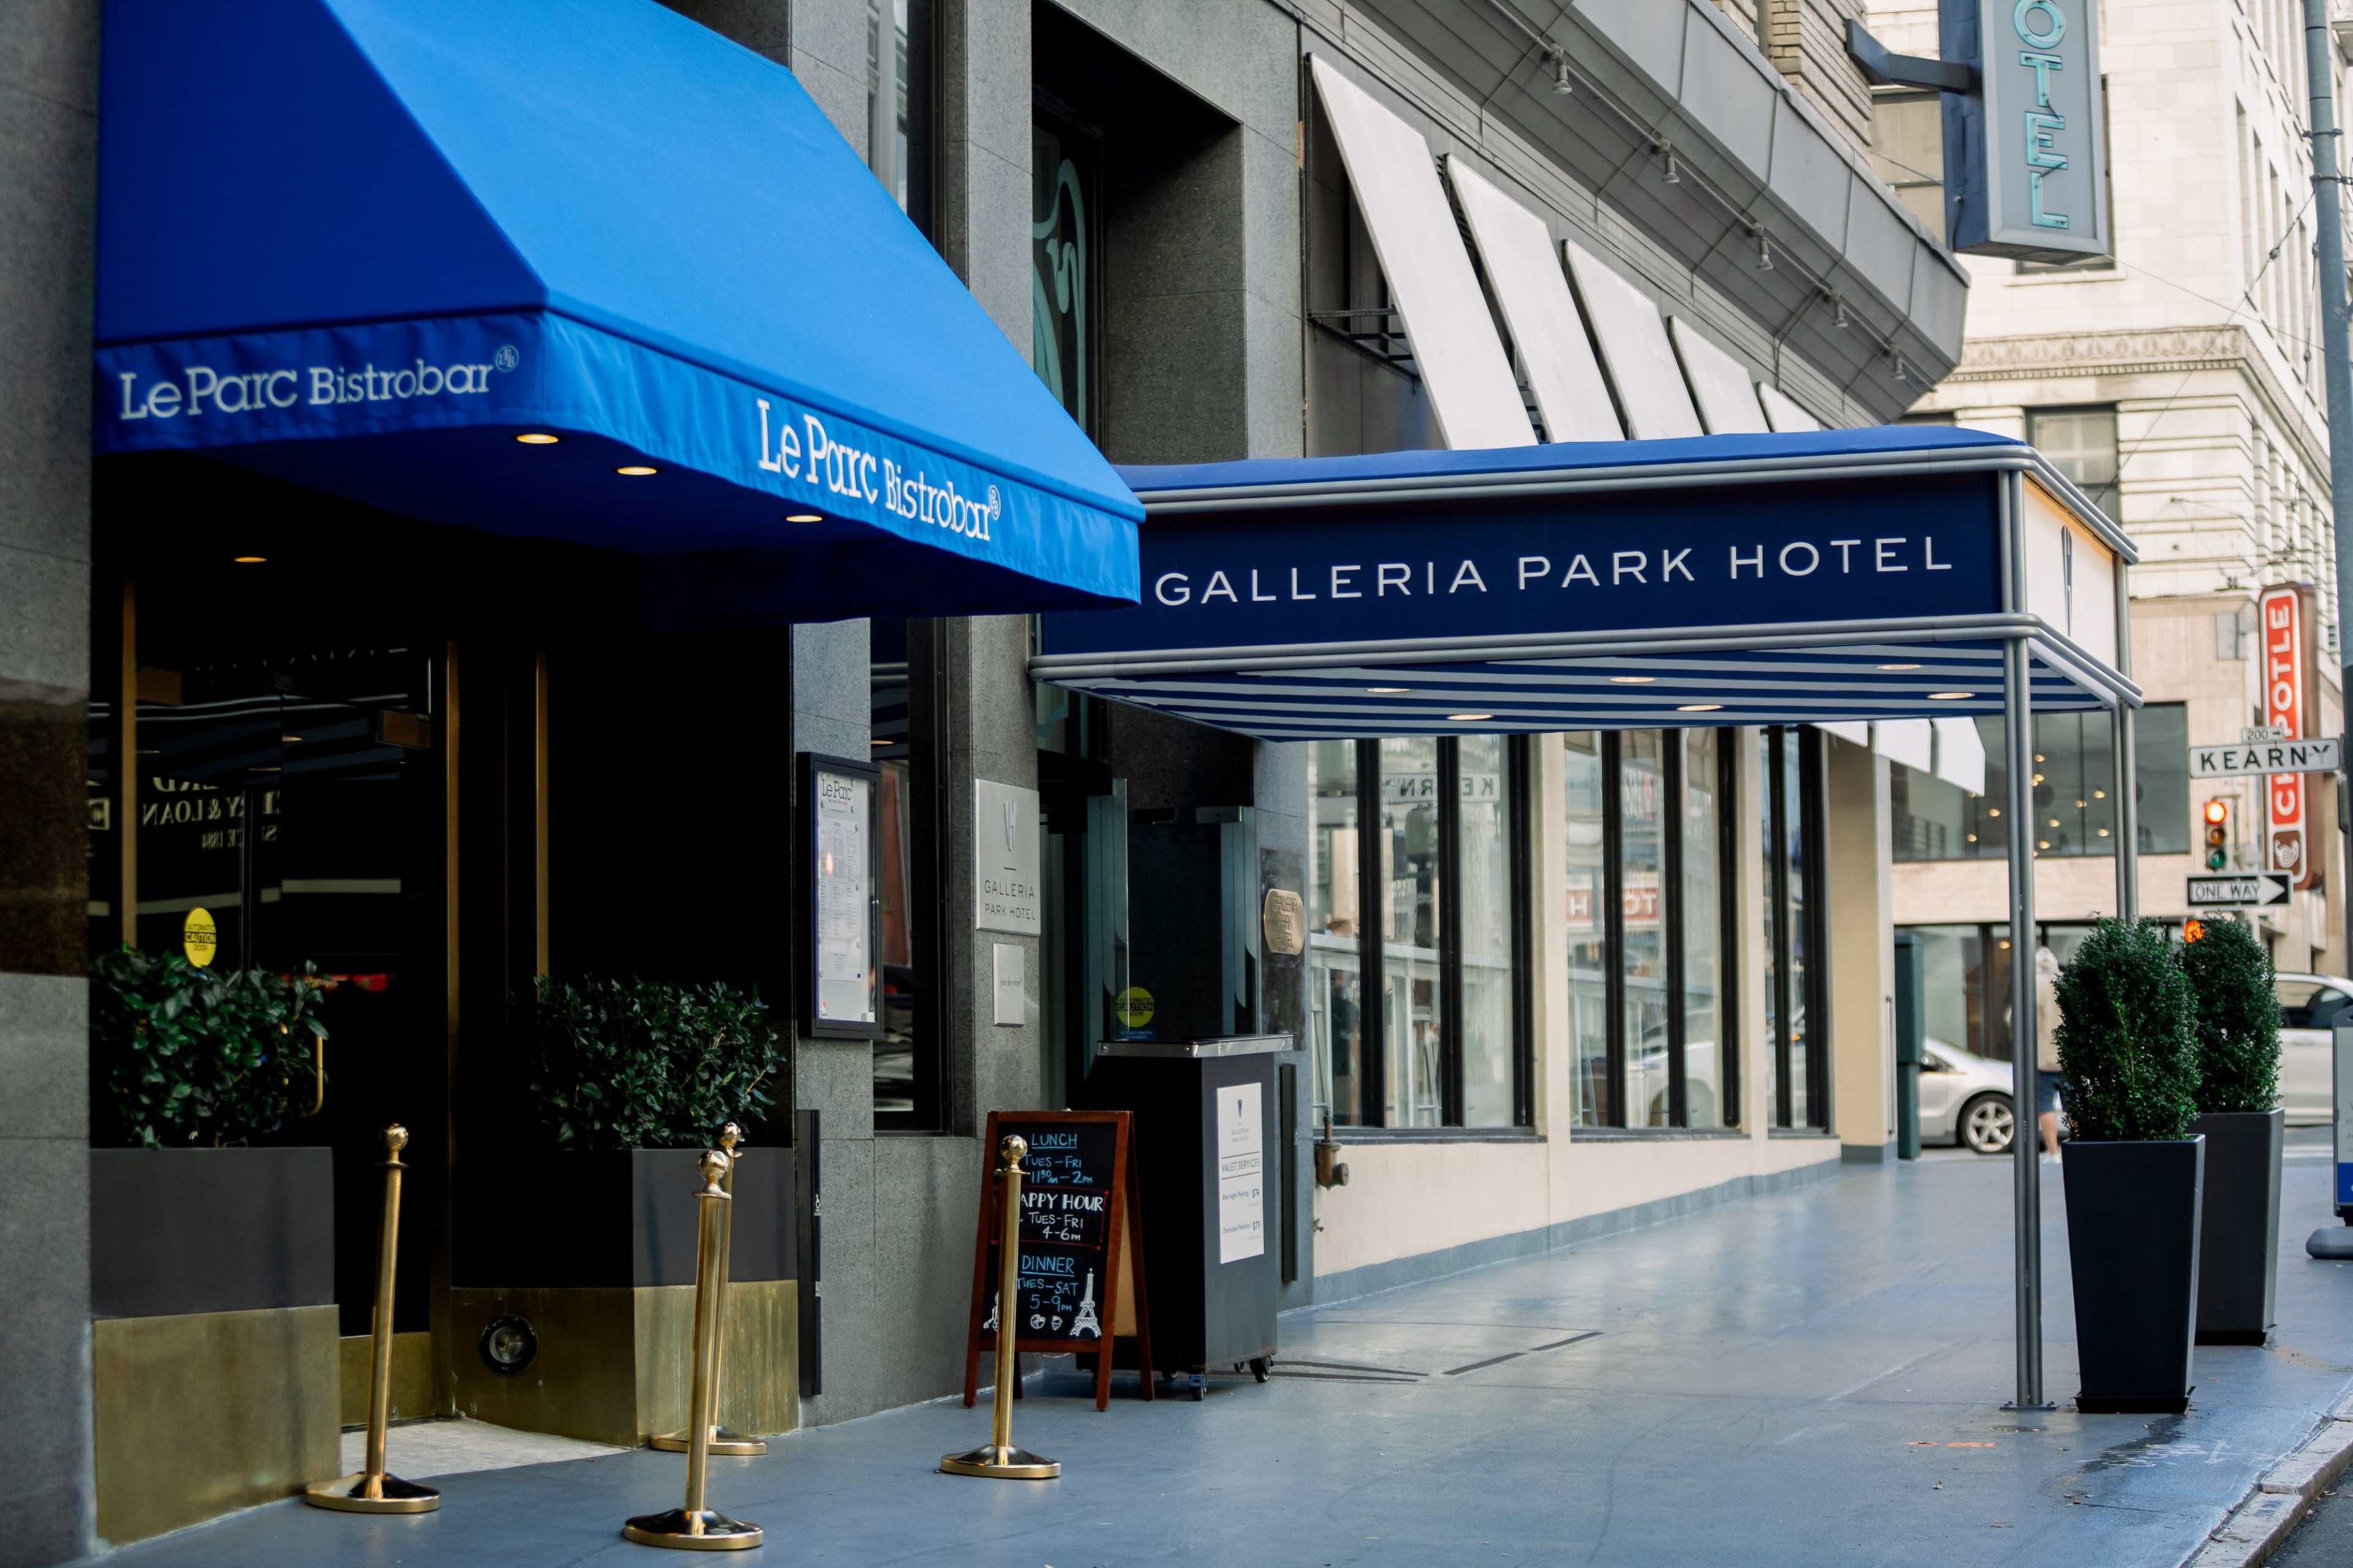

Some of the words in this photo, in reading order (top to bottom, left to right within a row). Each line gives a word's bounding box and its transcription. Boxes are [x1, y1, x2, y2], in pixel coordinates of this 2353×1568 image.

[120, 373, 181, 419] Le
[188, 366, 297, 415] Parc
[309, 359, 494, 405] Bistrobar
[757, 398, 801, 478] Le
[803, 413, 878, 504] Parc
[882, 458, 991, 541] Bistrobar
[1154, 559, 1487, 606] GALLERIA
[1518, 547, 1696, 590] PARK
[1730, 536, 1952, 580] HOTEL
[2268, 604, 2297, 817] CPOTLE
[2248, 730, 2268, 741] 200
[2200, 744, 2330, 772] KEARNY
[834, 781, 852, 801] Parc
[985, 879, 1035, 899] GALLERIA
[2196, 882, 2226, 901] ONE
[2230, 882, 2260, 900] WAY
[985, 903, 1007, 917] PARK
[1010, 906, 1036, 920] HOTEL
[186, 932, 216, 943] CAUTION
[1031, 1133, 1077, 1148] LUNCH
[1221, 1161, 1237, 1172] VALET
[1238, 1157, 1260, 1171] SERVICES
[1020, 1192, 1058, 1210] APPY
[1062, 1194, 1104, 1212] HOUR
[1021, 1254, 1075, 1274] DINNER
